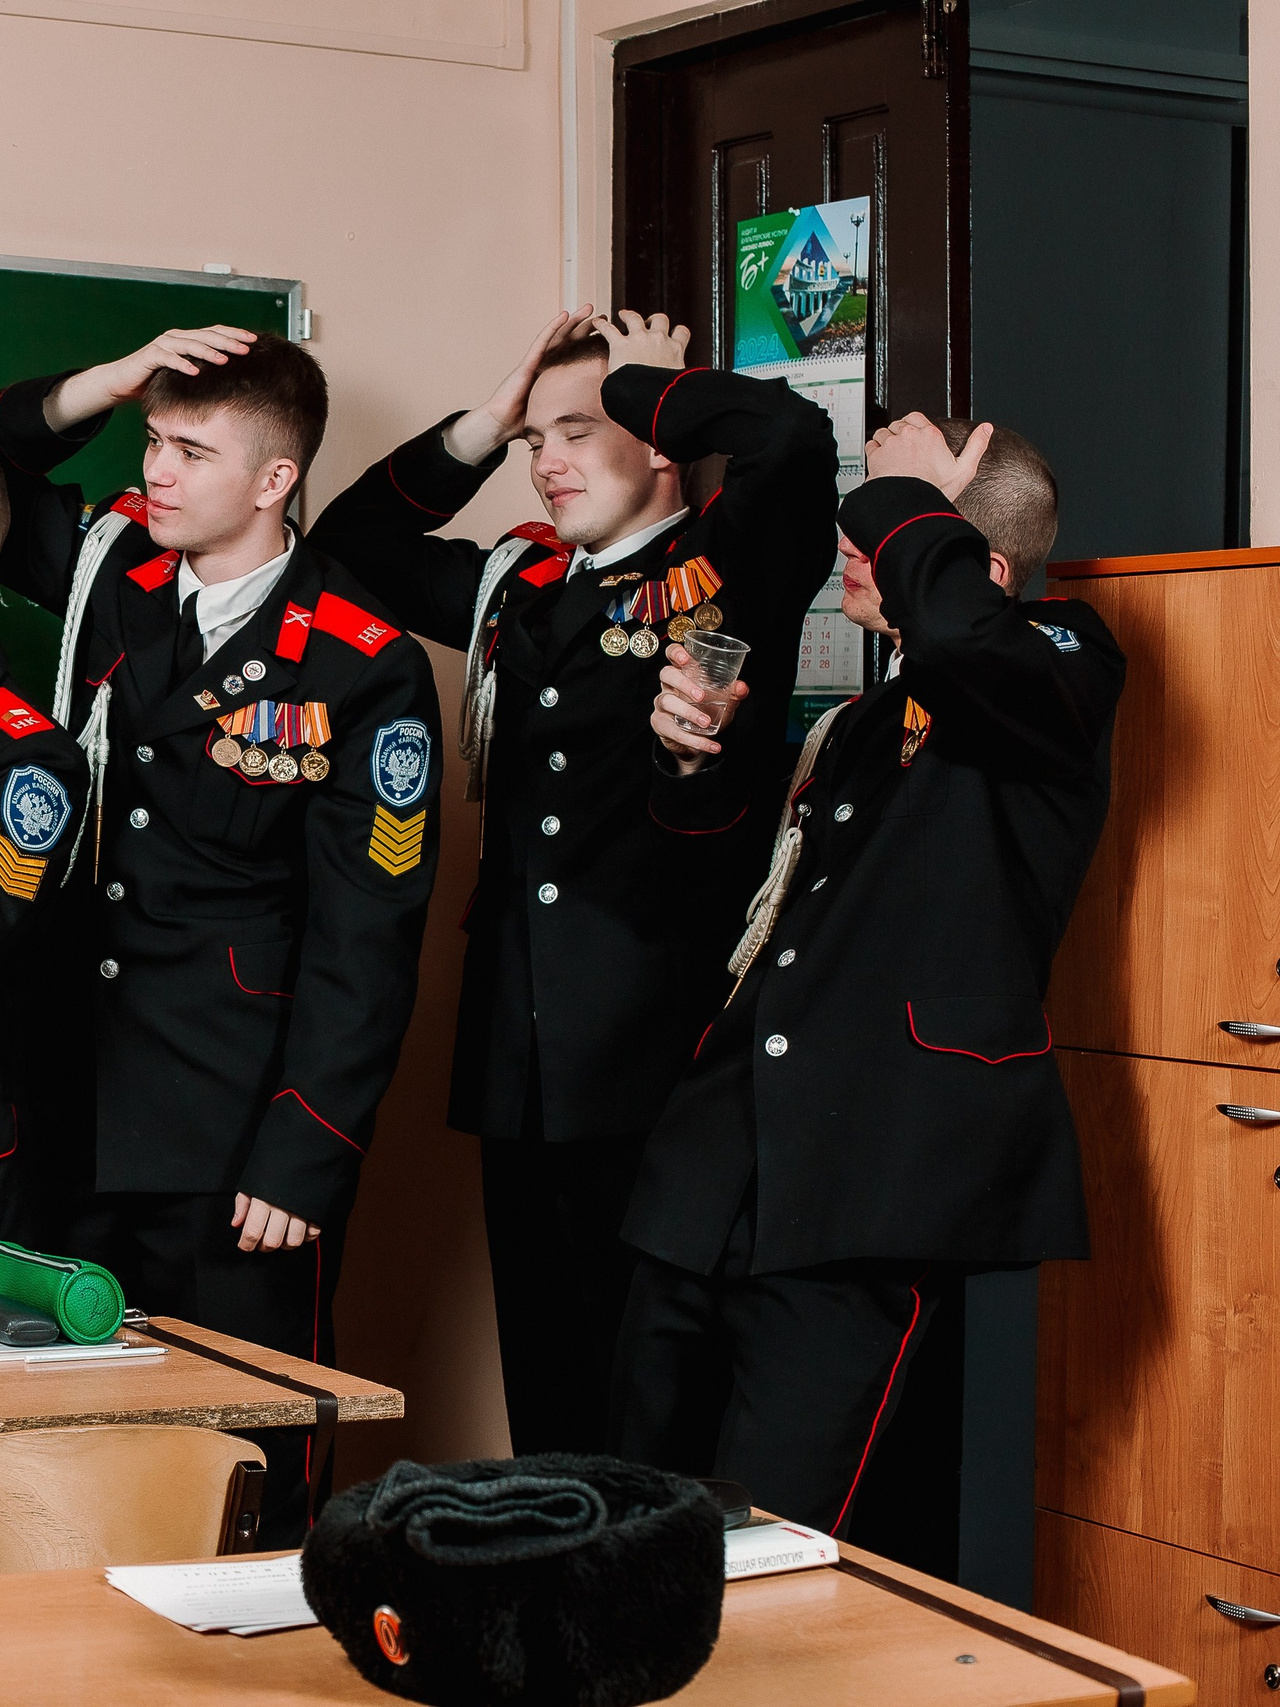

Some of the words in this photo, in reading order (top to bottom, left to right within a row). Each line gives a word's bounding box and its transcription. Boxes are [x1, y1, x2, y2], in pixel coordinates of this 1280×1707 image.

[736, 332, 780, 366] 2024
[812, 389, 818, 399] 3
[804, 616, 811, 626] 6
[823, 616, 829, 626] 7
[358, 623, 387, 645] НК
[803, 631, 813, 640] 13
[821, 631, 831, 640] 14
[801, 645, 812, 655] 20
[819, 645, 830, 655] 21
[801, 660, 811, 669] 27
[819, 660, 830, 669] 28
[10, 716, 41, 730] НК
[399, 727, 423, 739] РОССИЯ
[33, 773, 60, 797] РОССИЯ
[758, 1551, 805, 1569] БИОЛОГИЯ
